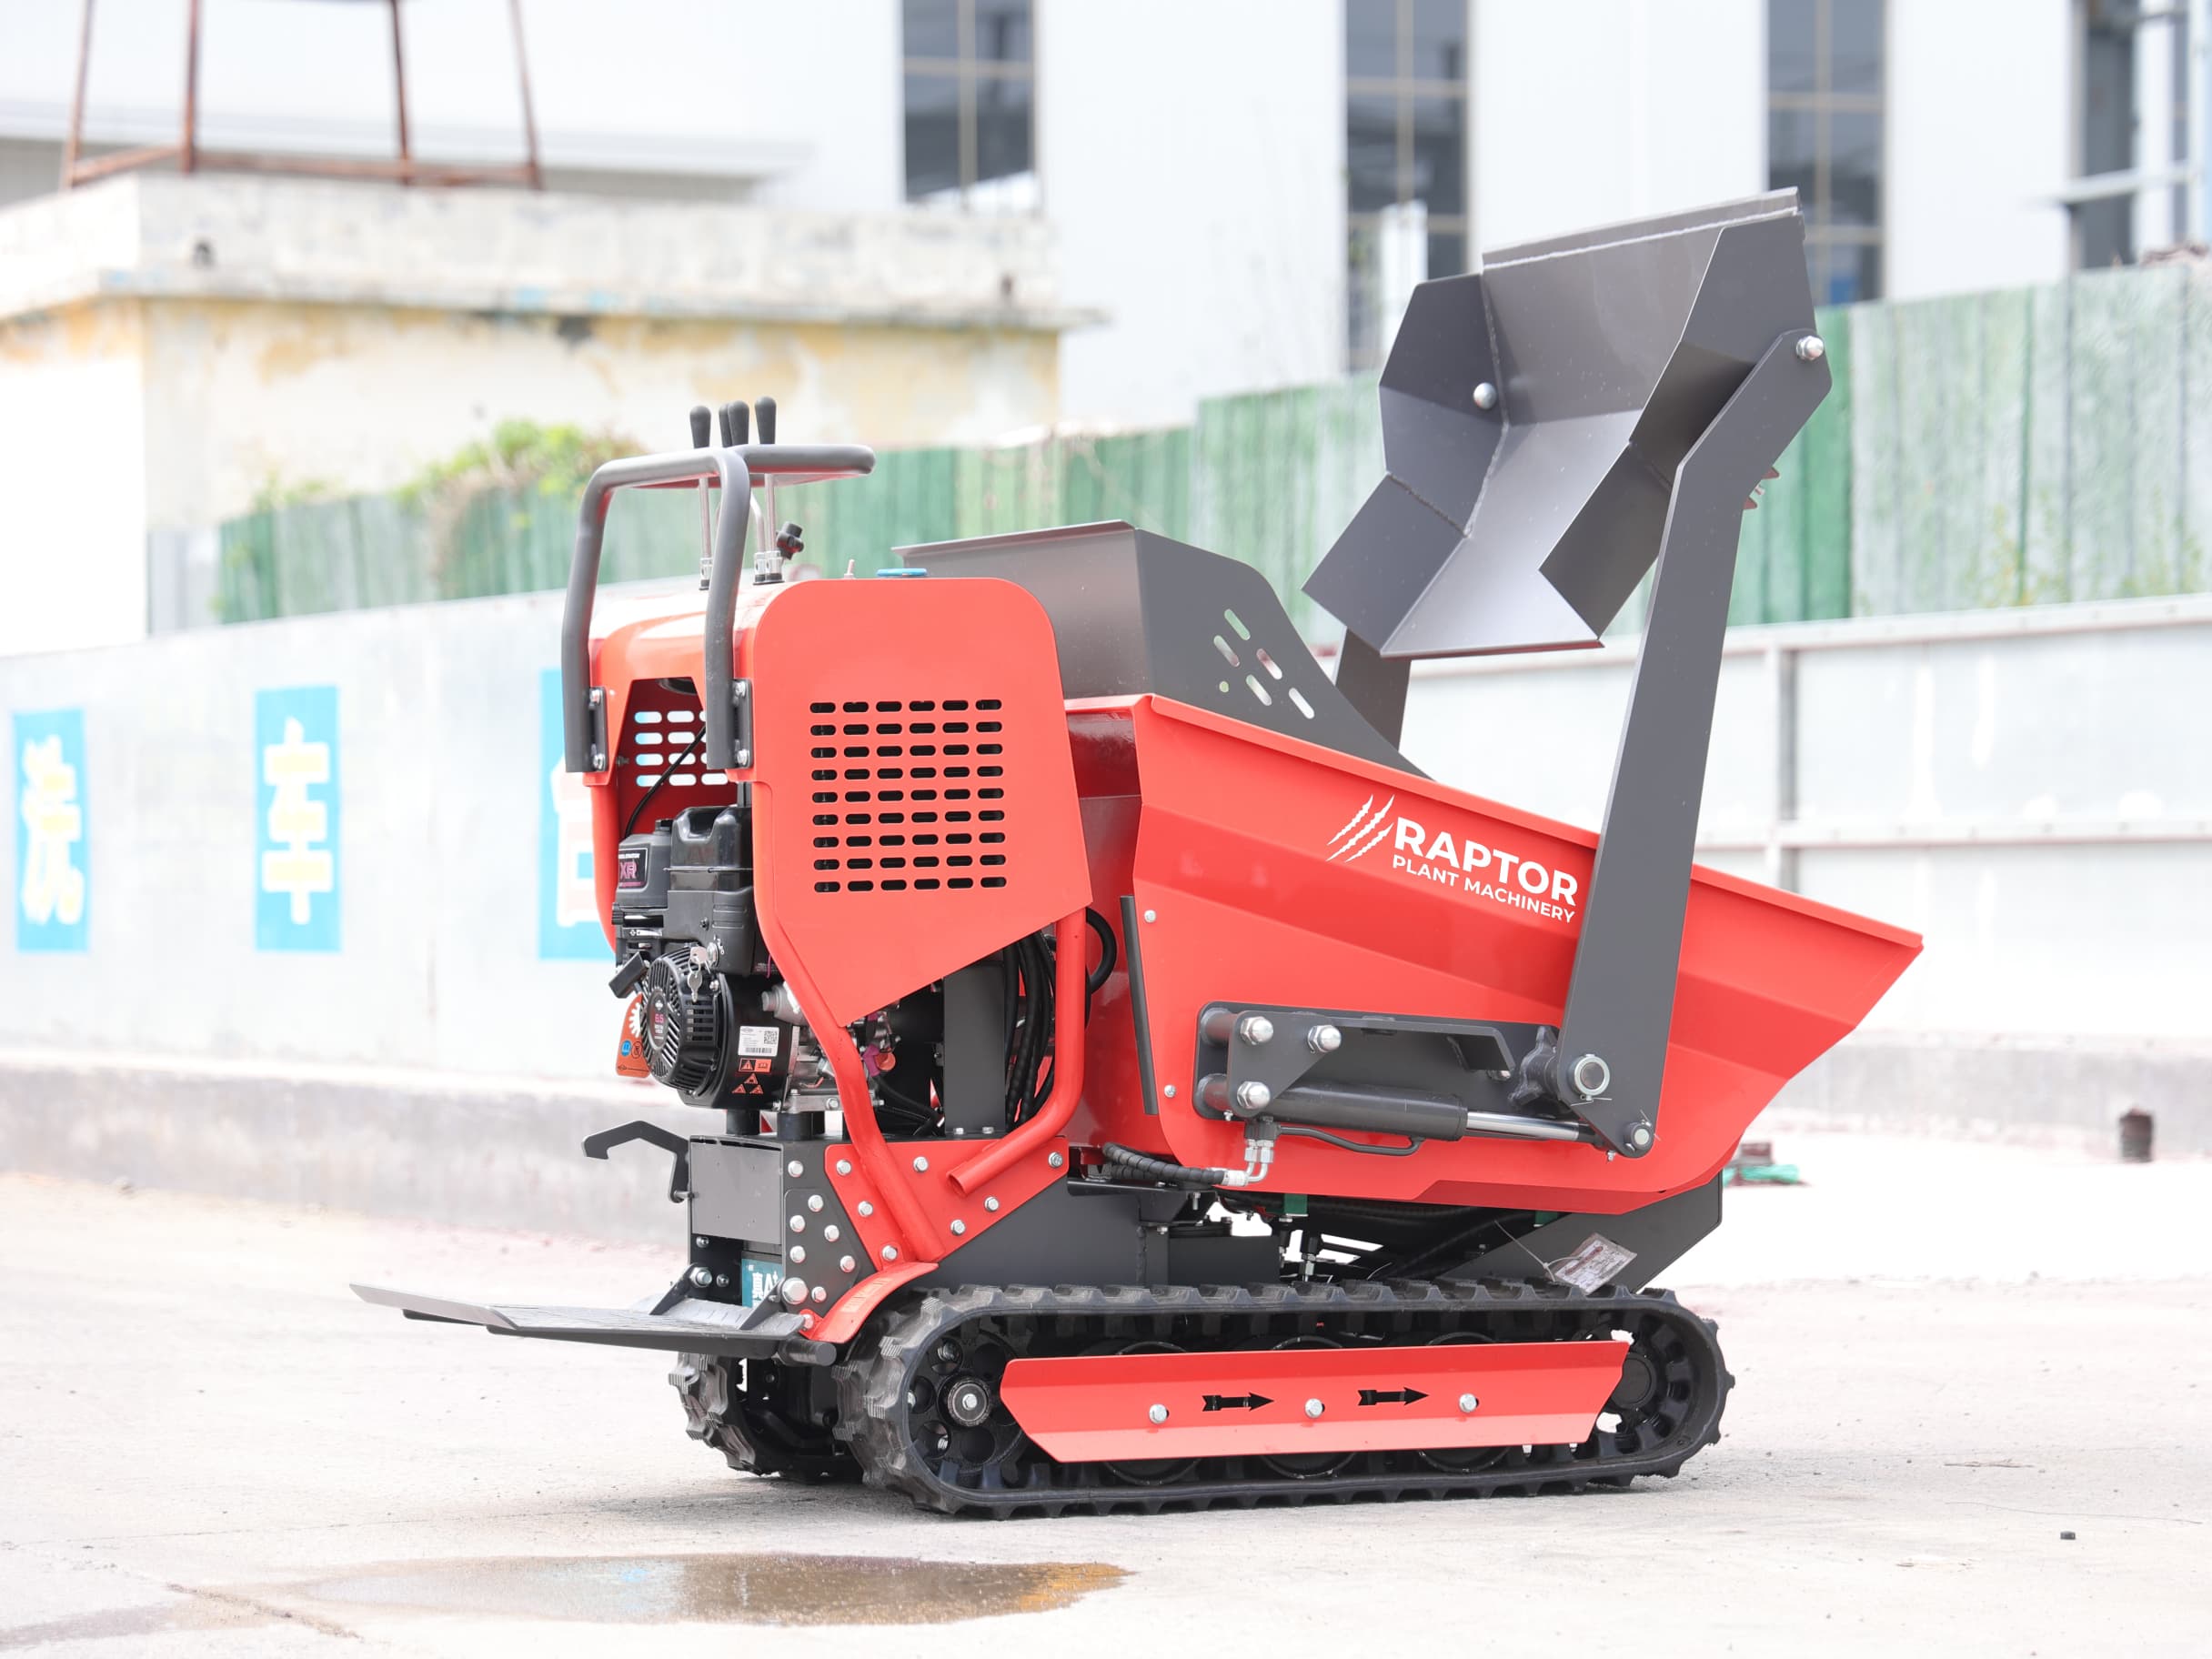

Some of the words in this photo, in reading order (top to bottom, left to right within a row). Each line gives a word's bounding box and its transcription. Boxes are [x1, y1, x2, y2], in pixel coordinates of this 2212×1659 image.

[261, 716, 334, 925] 车
[1393, 816, 1578, 907] RAPTOR
[1392, 854, 1460, 888] PLANT
[1463, 877, 1576, 924] MACHINERY
